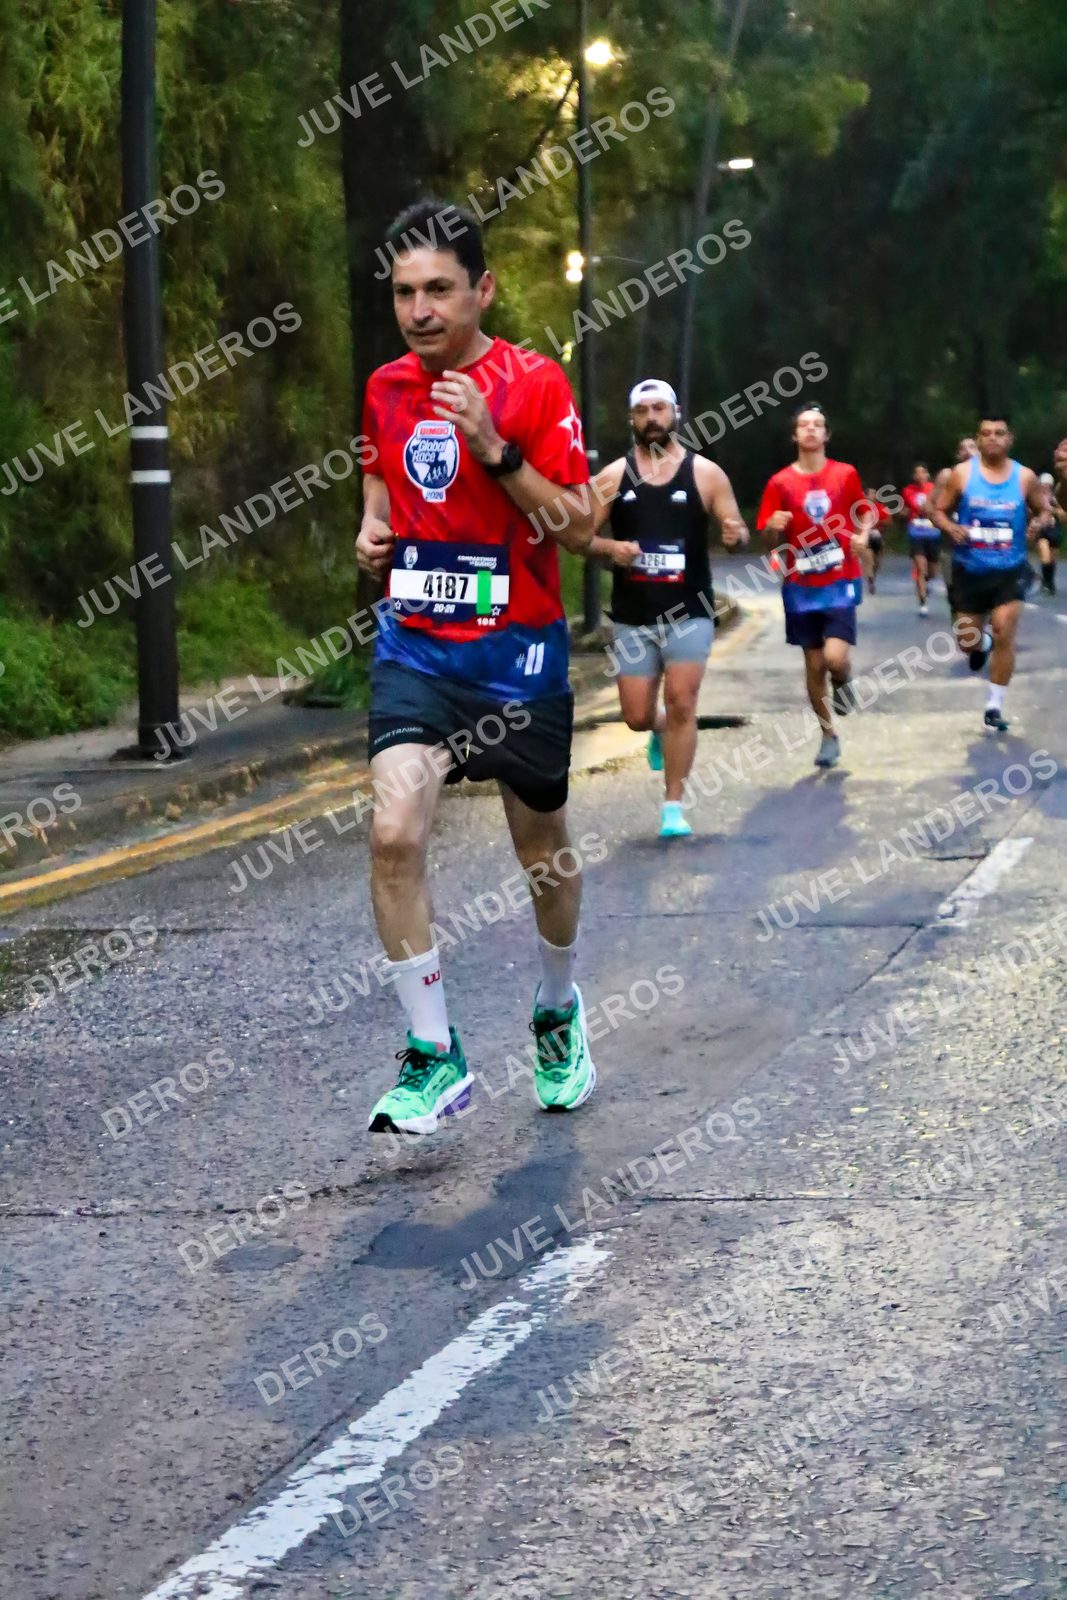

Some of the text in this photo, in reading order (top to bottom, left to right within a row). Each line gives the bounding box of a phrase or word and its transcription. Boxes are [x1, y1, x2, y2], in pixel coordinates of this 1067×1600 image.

[418, 440, 447, 453] Global
[412, 452, 436, 463] Race
[640, 554, 666, 567] 4264
[423, 574, 469, 600] 4187
[476, 618, 496, 626] 10K
